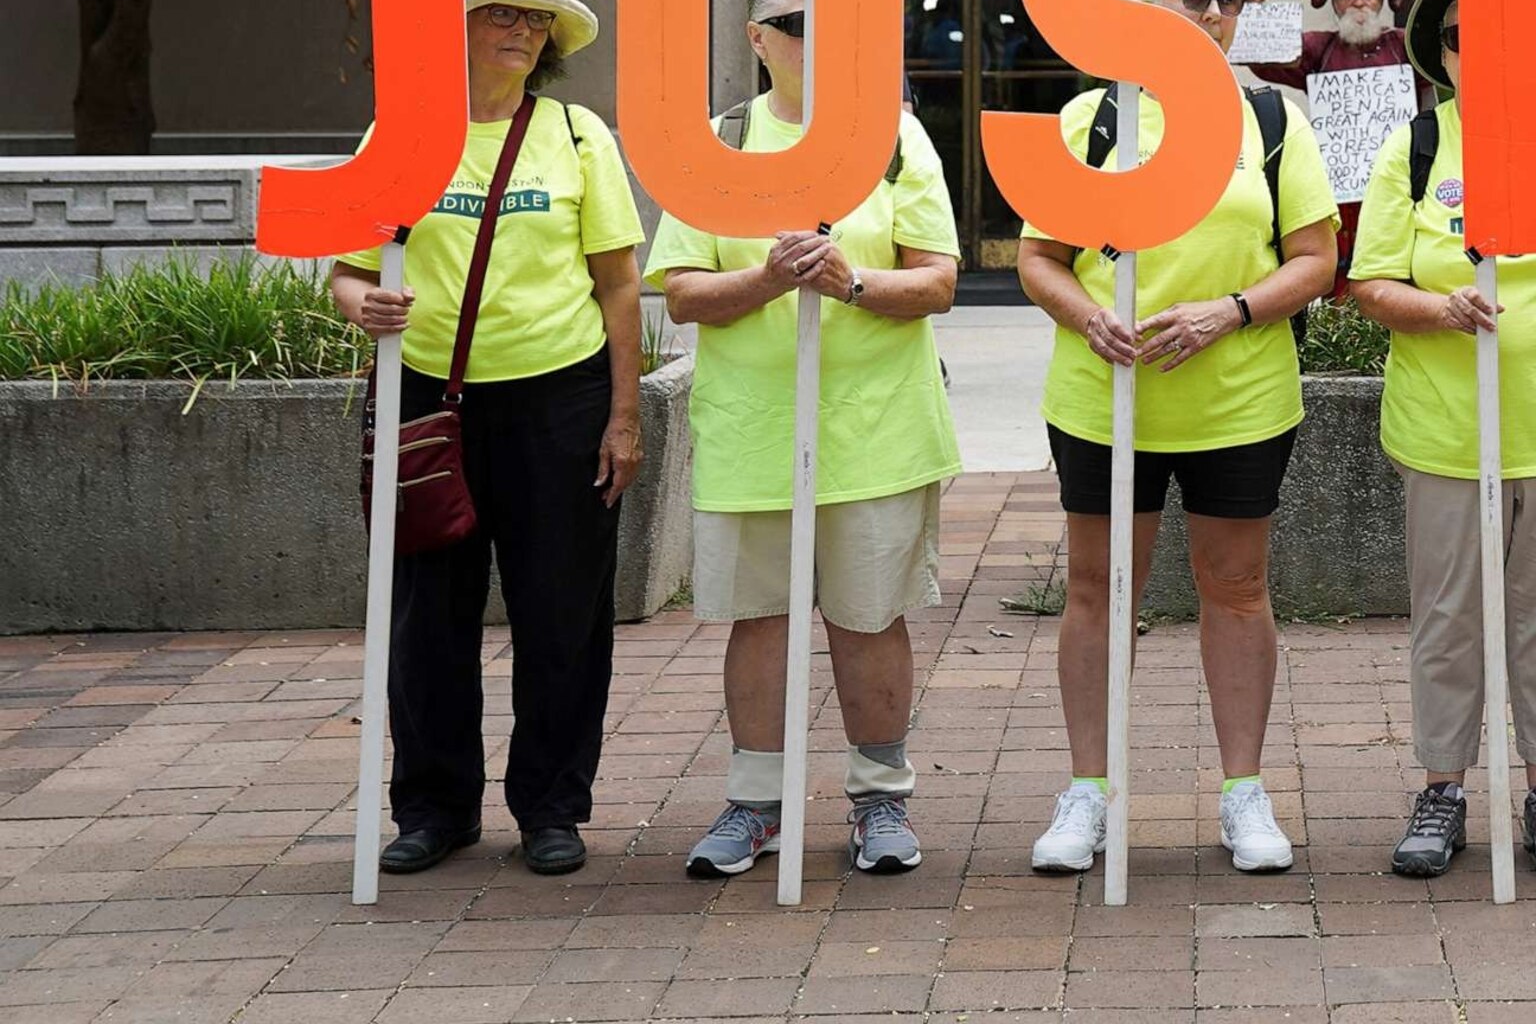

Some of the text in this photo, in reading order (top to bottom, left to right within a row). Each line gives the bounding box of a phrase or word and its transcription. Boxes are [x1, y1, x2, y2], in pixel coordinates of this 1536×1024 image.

[1321, 69, 1383, 89] MAKE
[1314, 78, 1411, 105] AMERICA'S
[1331, 97, 1396, 115] PENIS
[1310, 107, 1413, 131] GREAT AGAIN
[1327, 123, 1393, 141] WITH A
